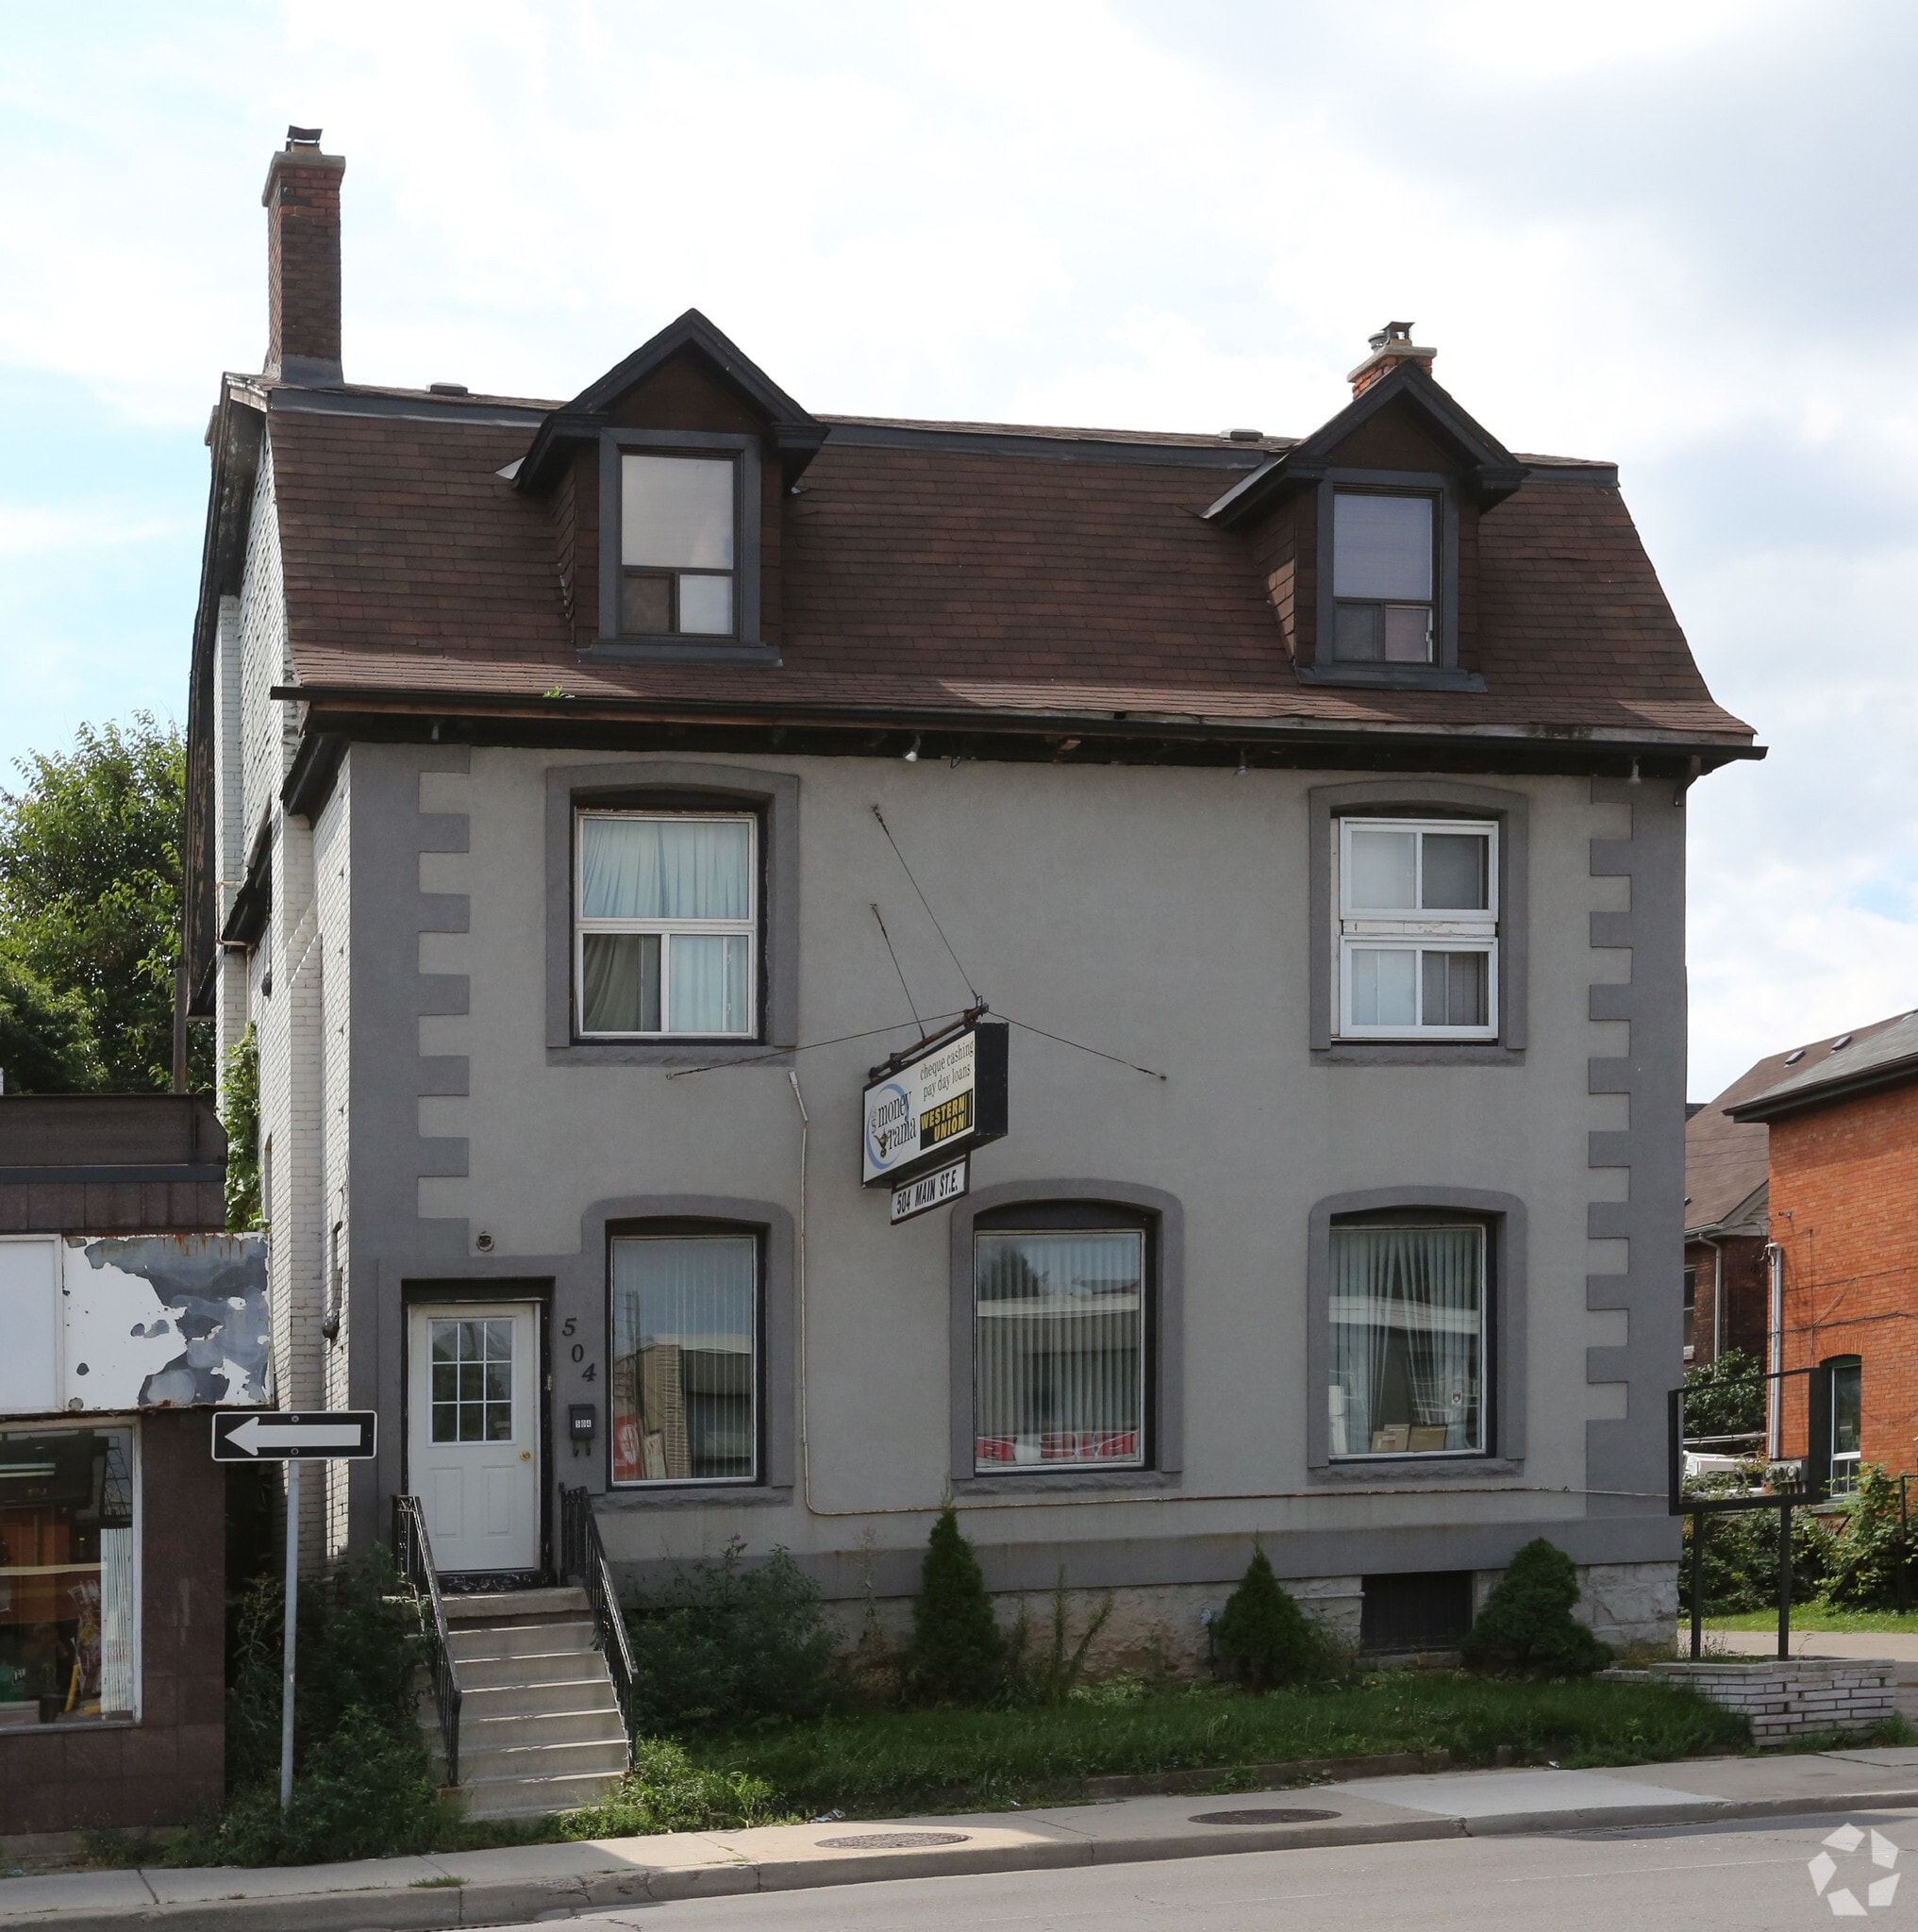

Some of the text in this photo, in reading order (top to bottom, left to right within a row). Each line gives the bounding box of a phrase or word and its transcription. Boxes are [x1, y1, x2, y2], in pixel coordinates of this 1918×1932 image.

[920, 1041, 974, 1080] cheque cashing
[924, 1063, 971, 1102] pay day loans
[877, 1091, 911, 1127] money
[921, 1094, 965, 1131] WESTERN
[934, 1113, 966, 1141] UNION
[888, 1117, 916, 1150] rama
[897, 1189, 911, 1214] 504
[915, 1177, 936, 1207] MAIN
